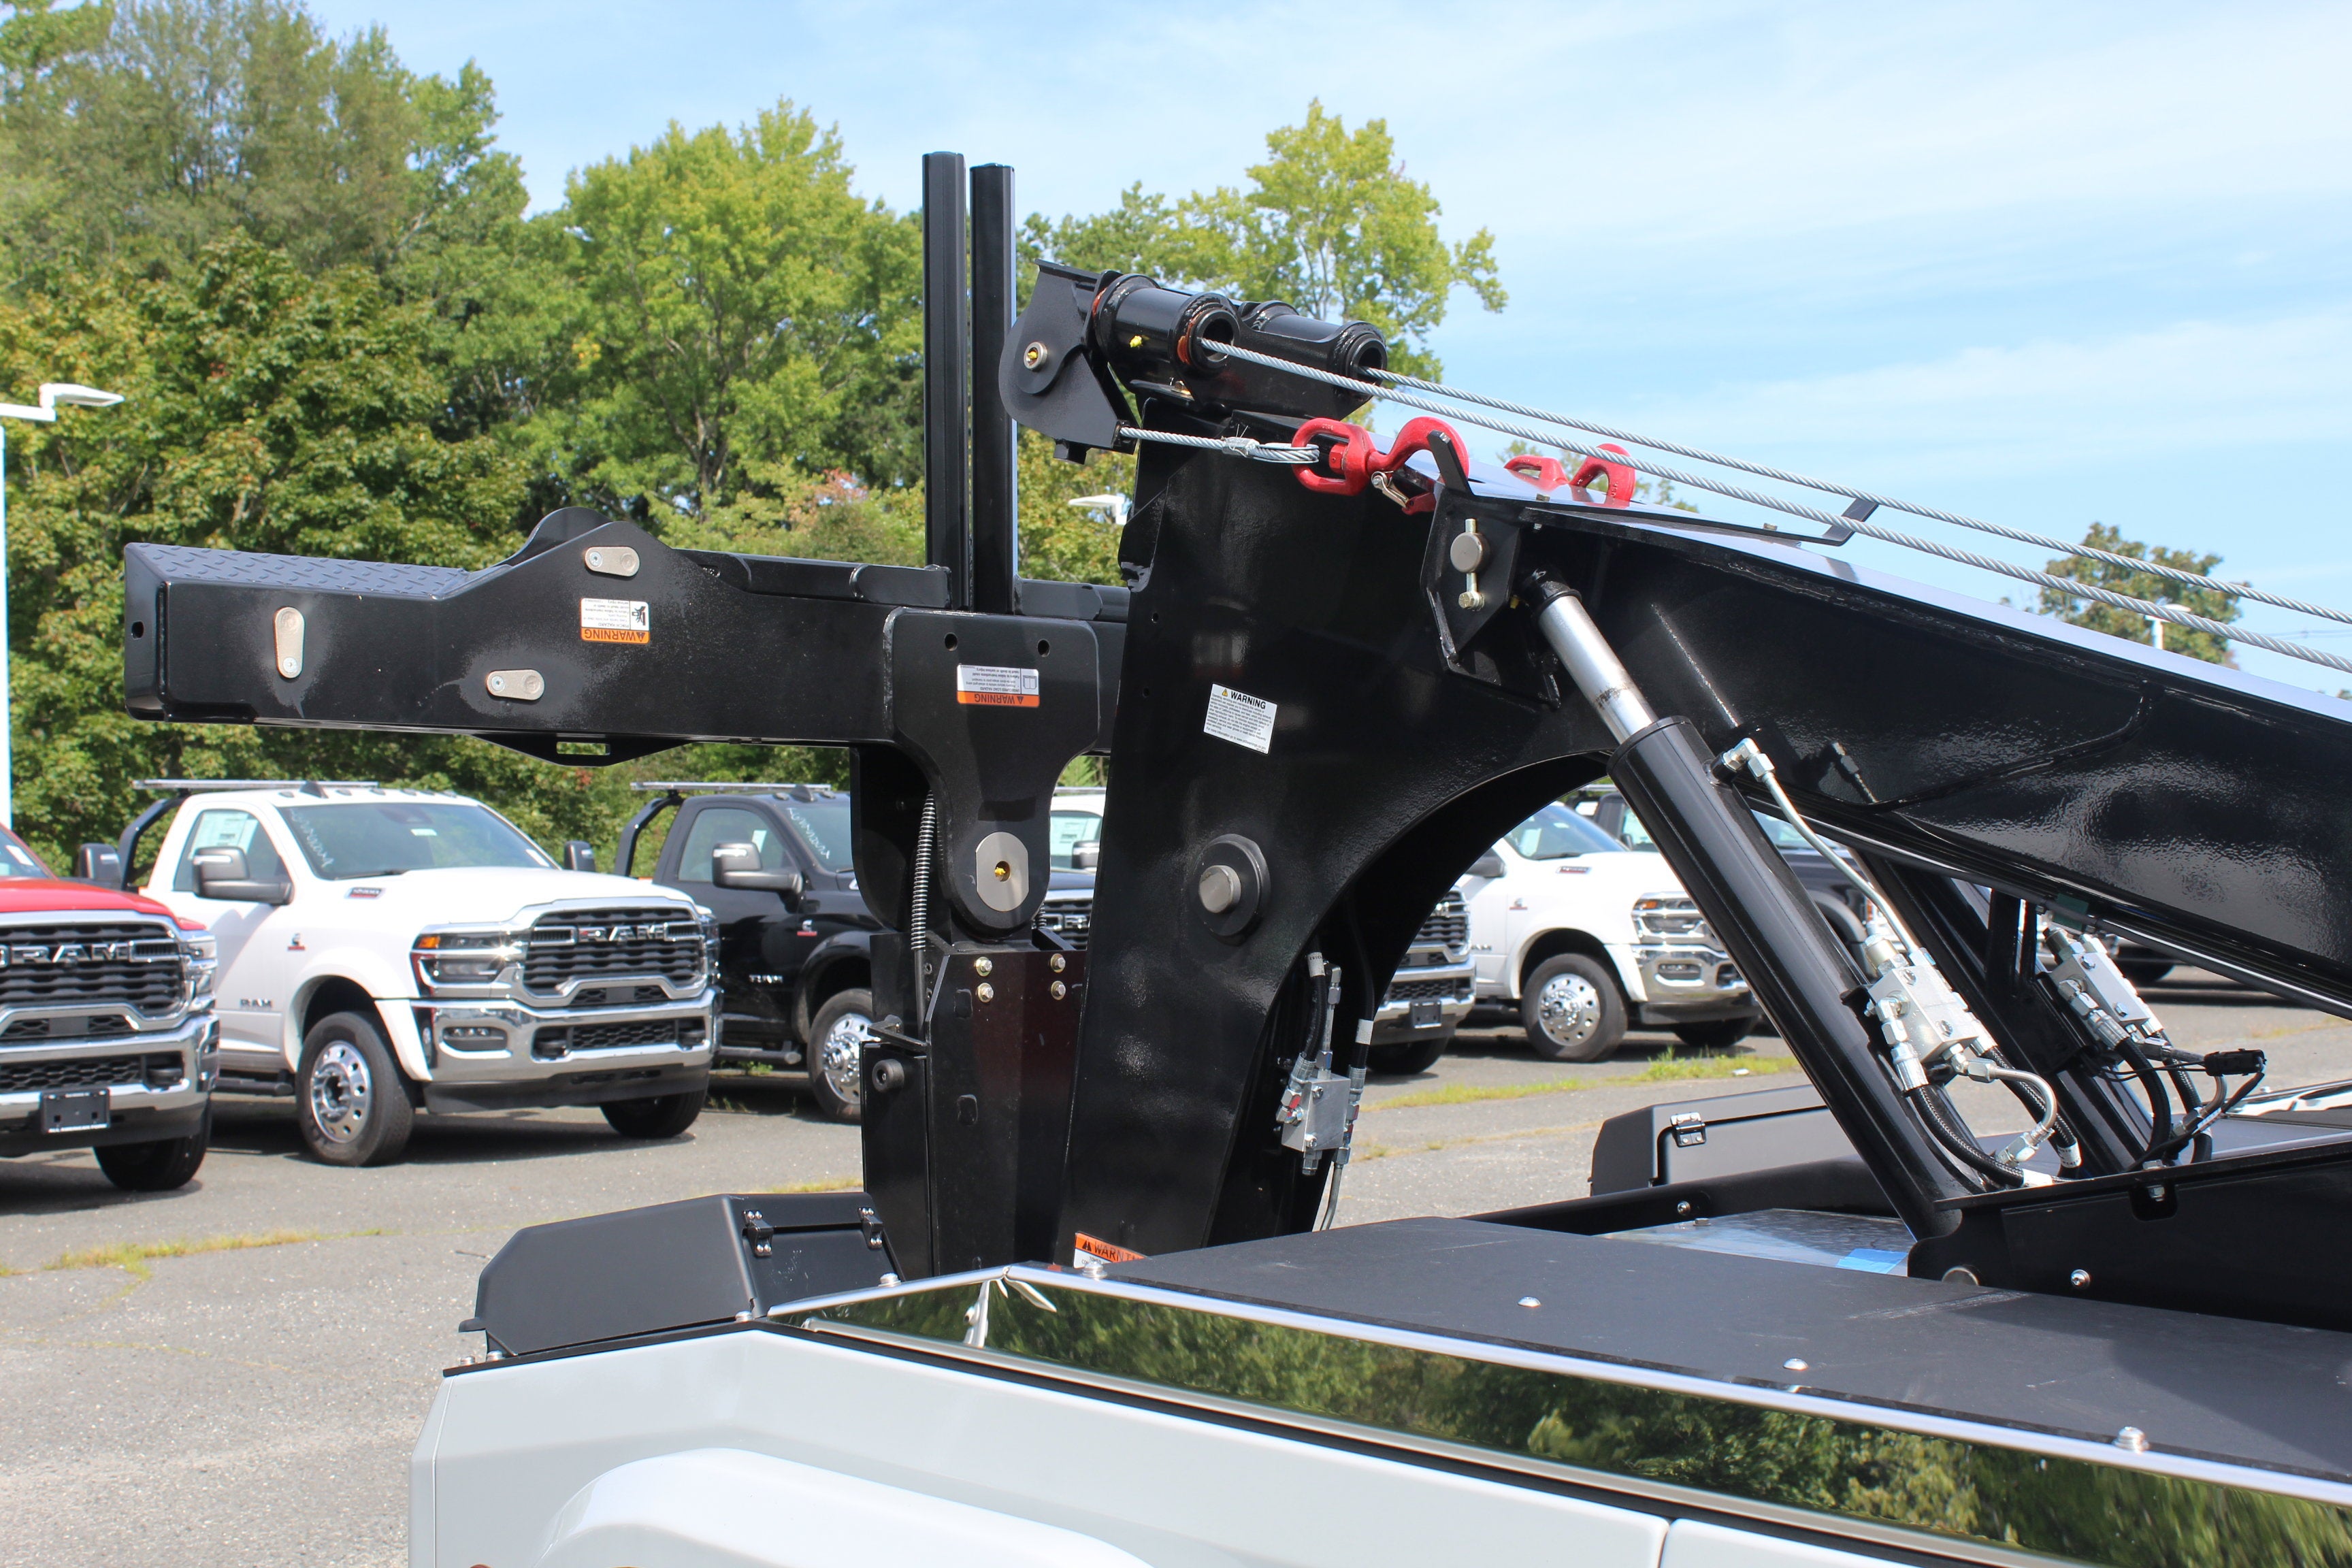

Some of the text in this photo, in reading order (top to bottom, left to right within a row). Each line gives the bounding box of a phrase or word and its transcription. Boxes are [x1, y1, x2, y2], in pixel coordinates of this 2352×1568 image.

[585, 629, 636, 641] WARNING
[975, 693, 1015, 704] WARNING
[1230, 691, 1266, 709] WARNING
[578, 924, 664, 942] RAM
[10, 943, 129, 964] RAM
[240, 998, 272, 1007] RAM
